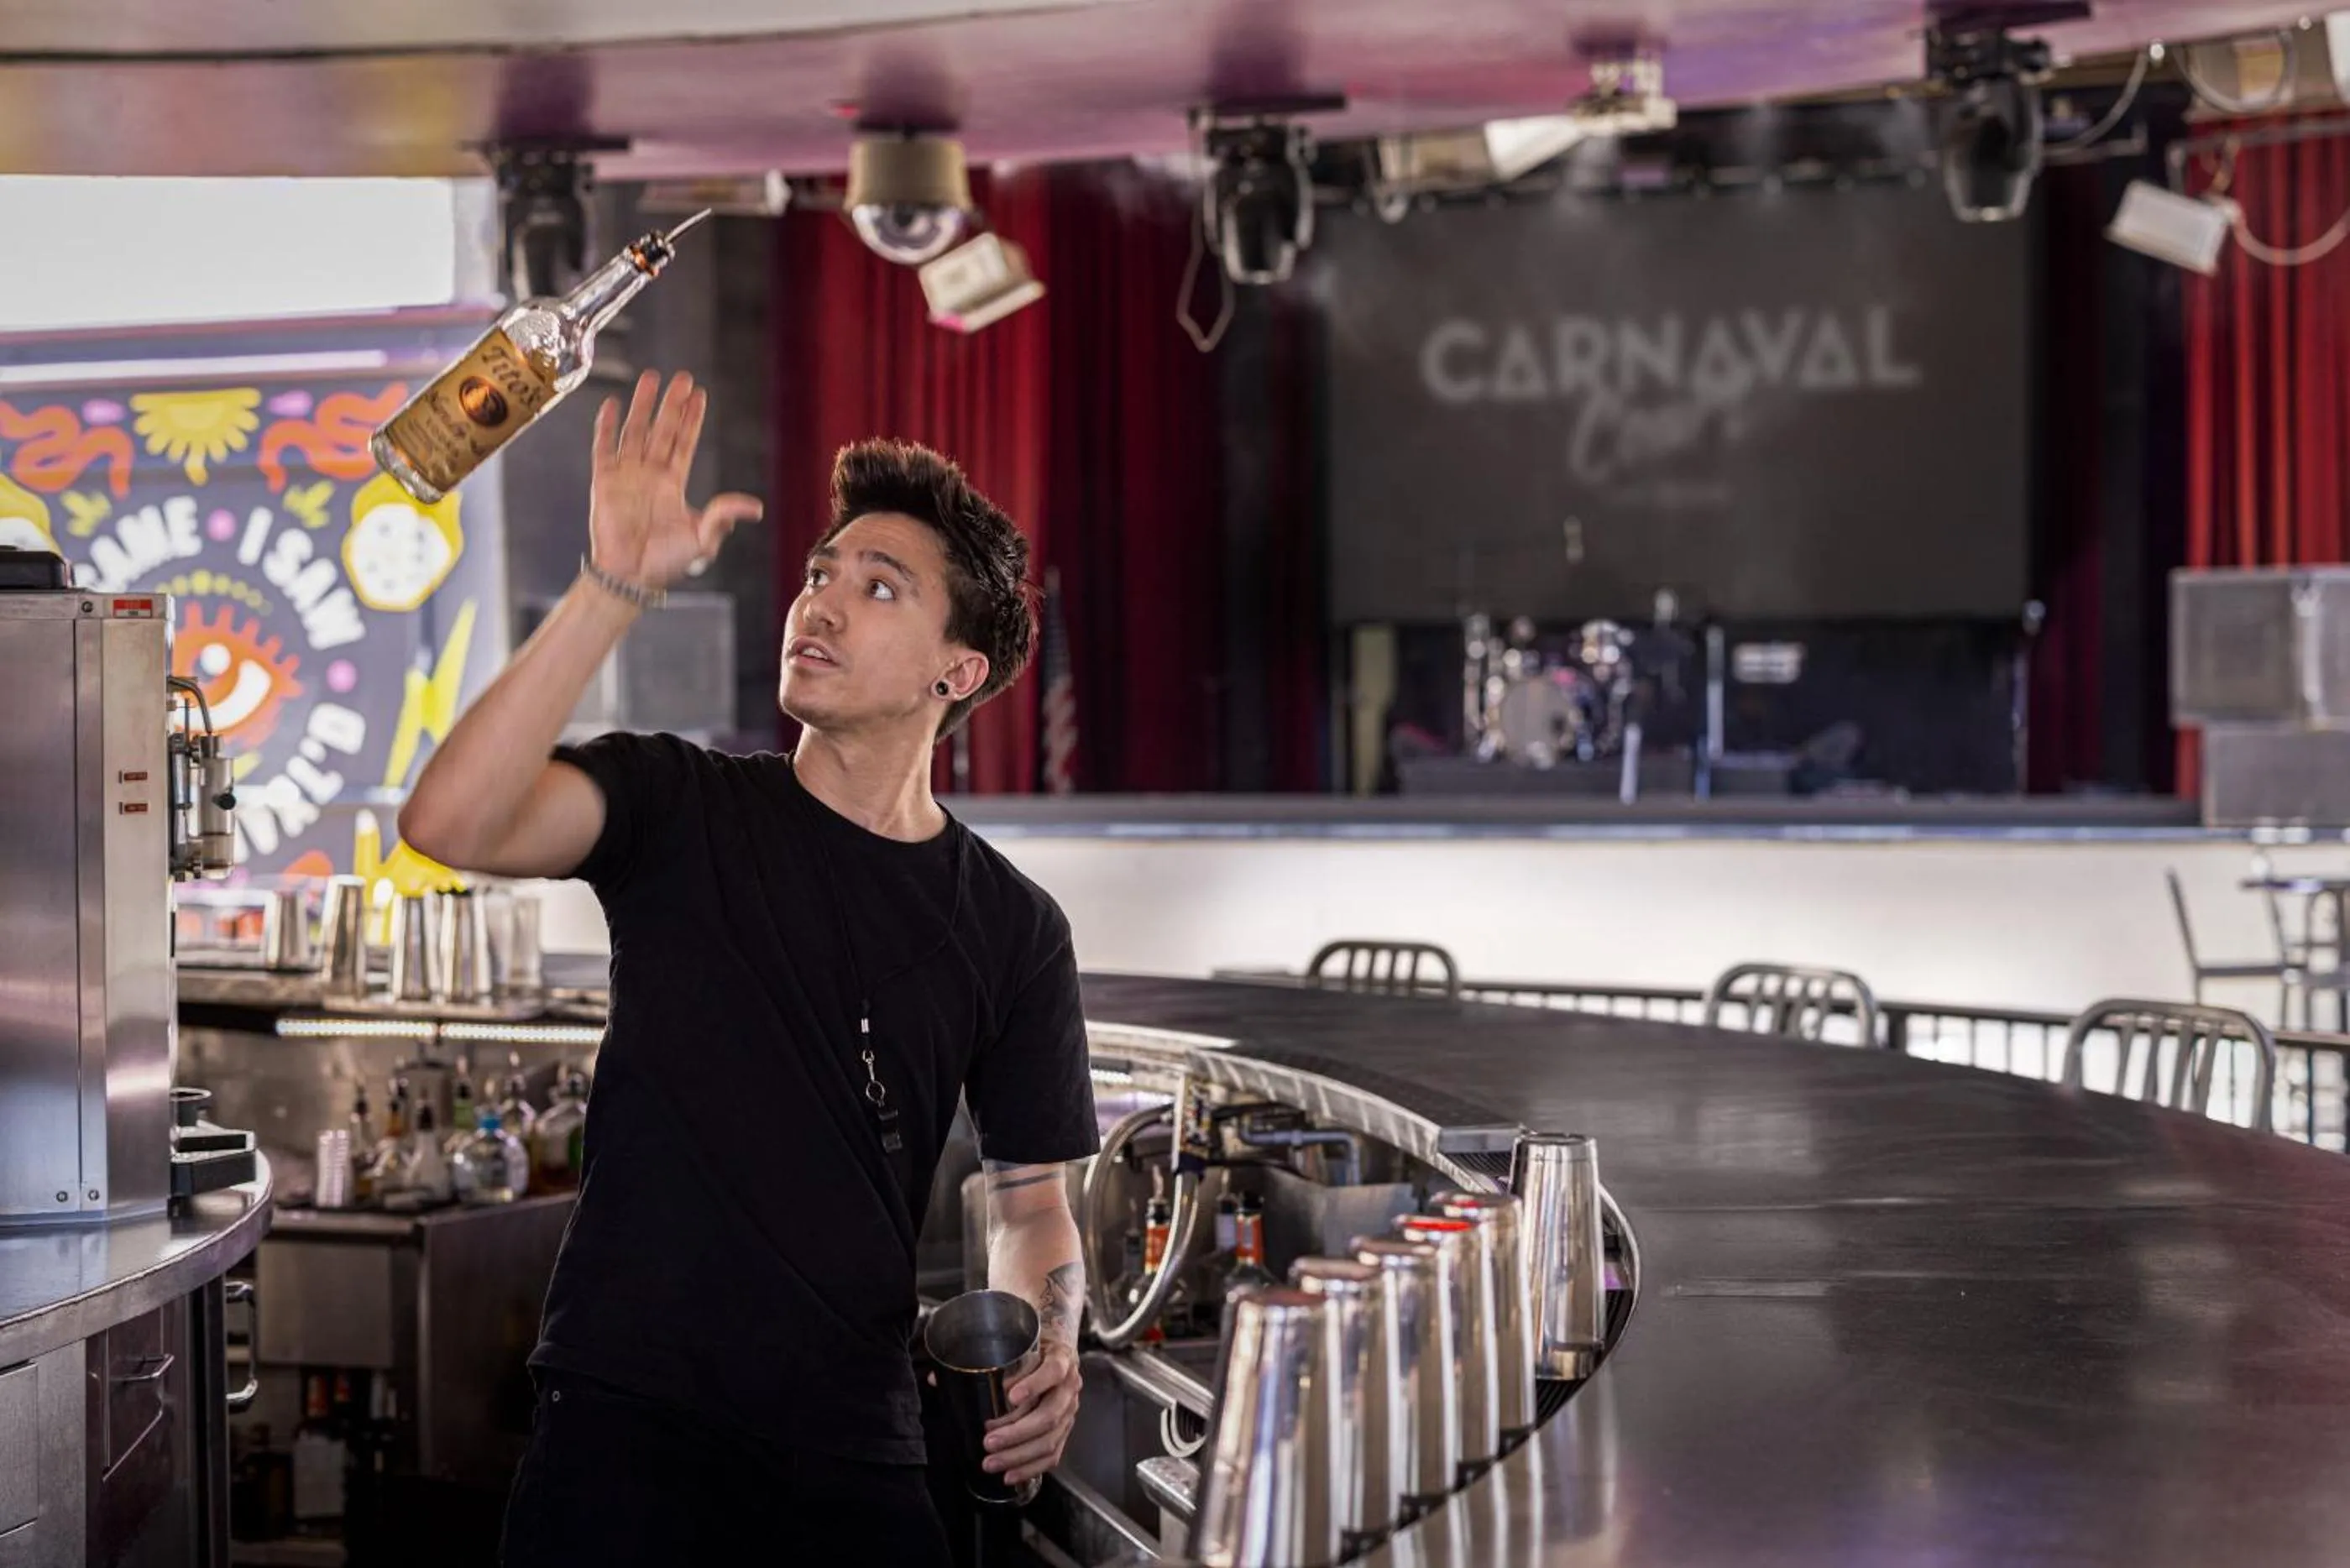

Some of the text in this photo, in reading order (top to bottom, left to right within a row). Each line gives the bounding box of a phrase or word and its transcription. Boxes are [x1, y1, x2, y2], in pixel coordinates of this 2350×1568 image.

[1421, 307, 1921, 403] CARNAVAL
[238, 507, 273, 565] I
[262, 528, 365, 651] SAW
